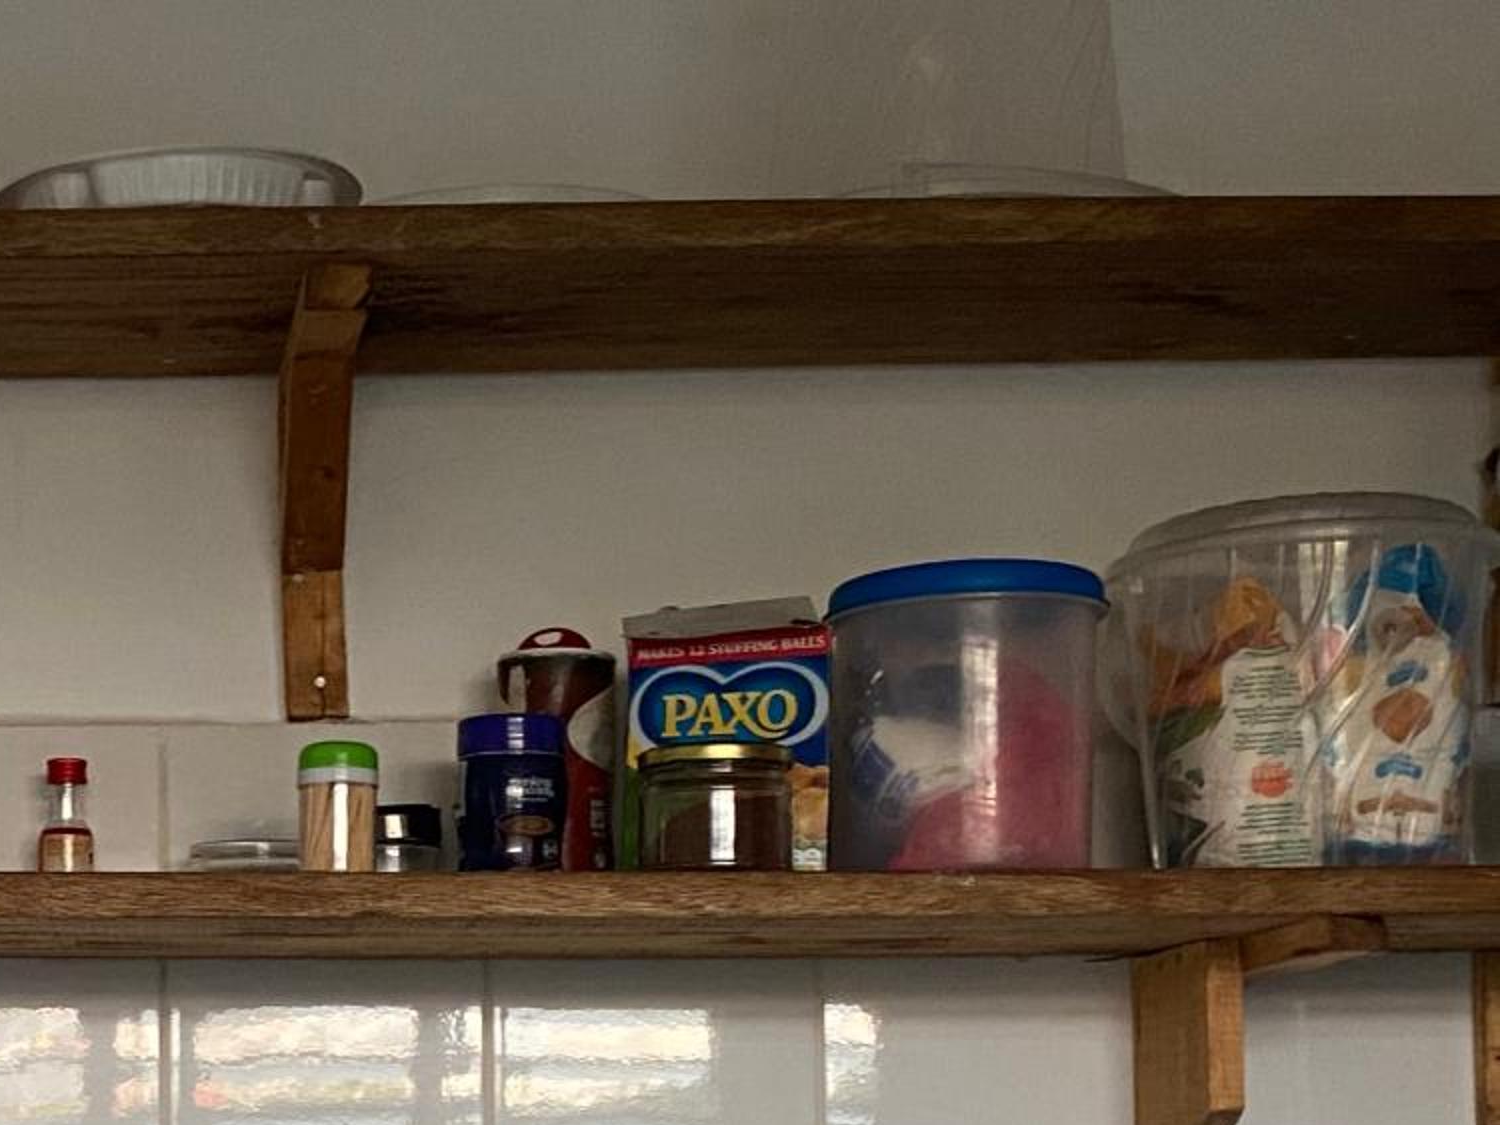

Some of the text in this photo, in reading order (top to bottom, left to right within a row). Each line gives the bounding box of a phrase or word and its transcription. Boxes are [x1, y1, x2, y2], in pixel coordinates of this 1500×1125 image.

[707, 639, 779, 656] STUFFING
[781, 634, 826, 650] BALLS
[661, 689, 798, 739] PAXO
